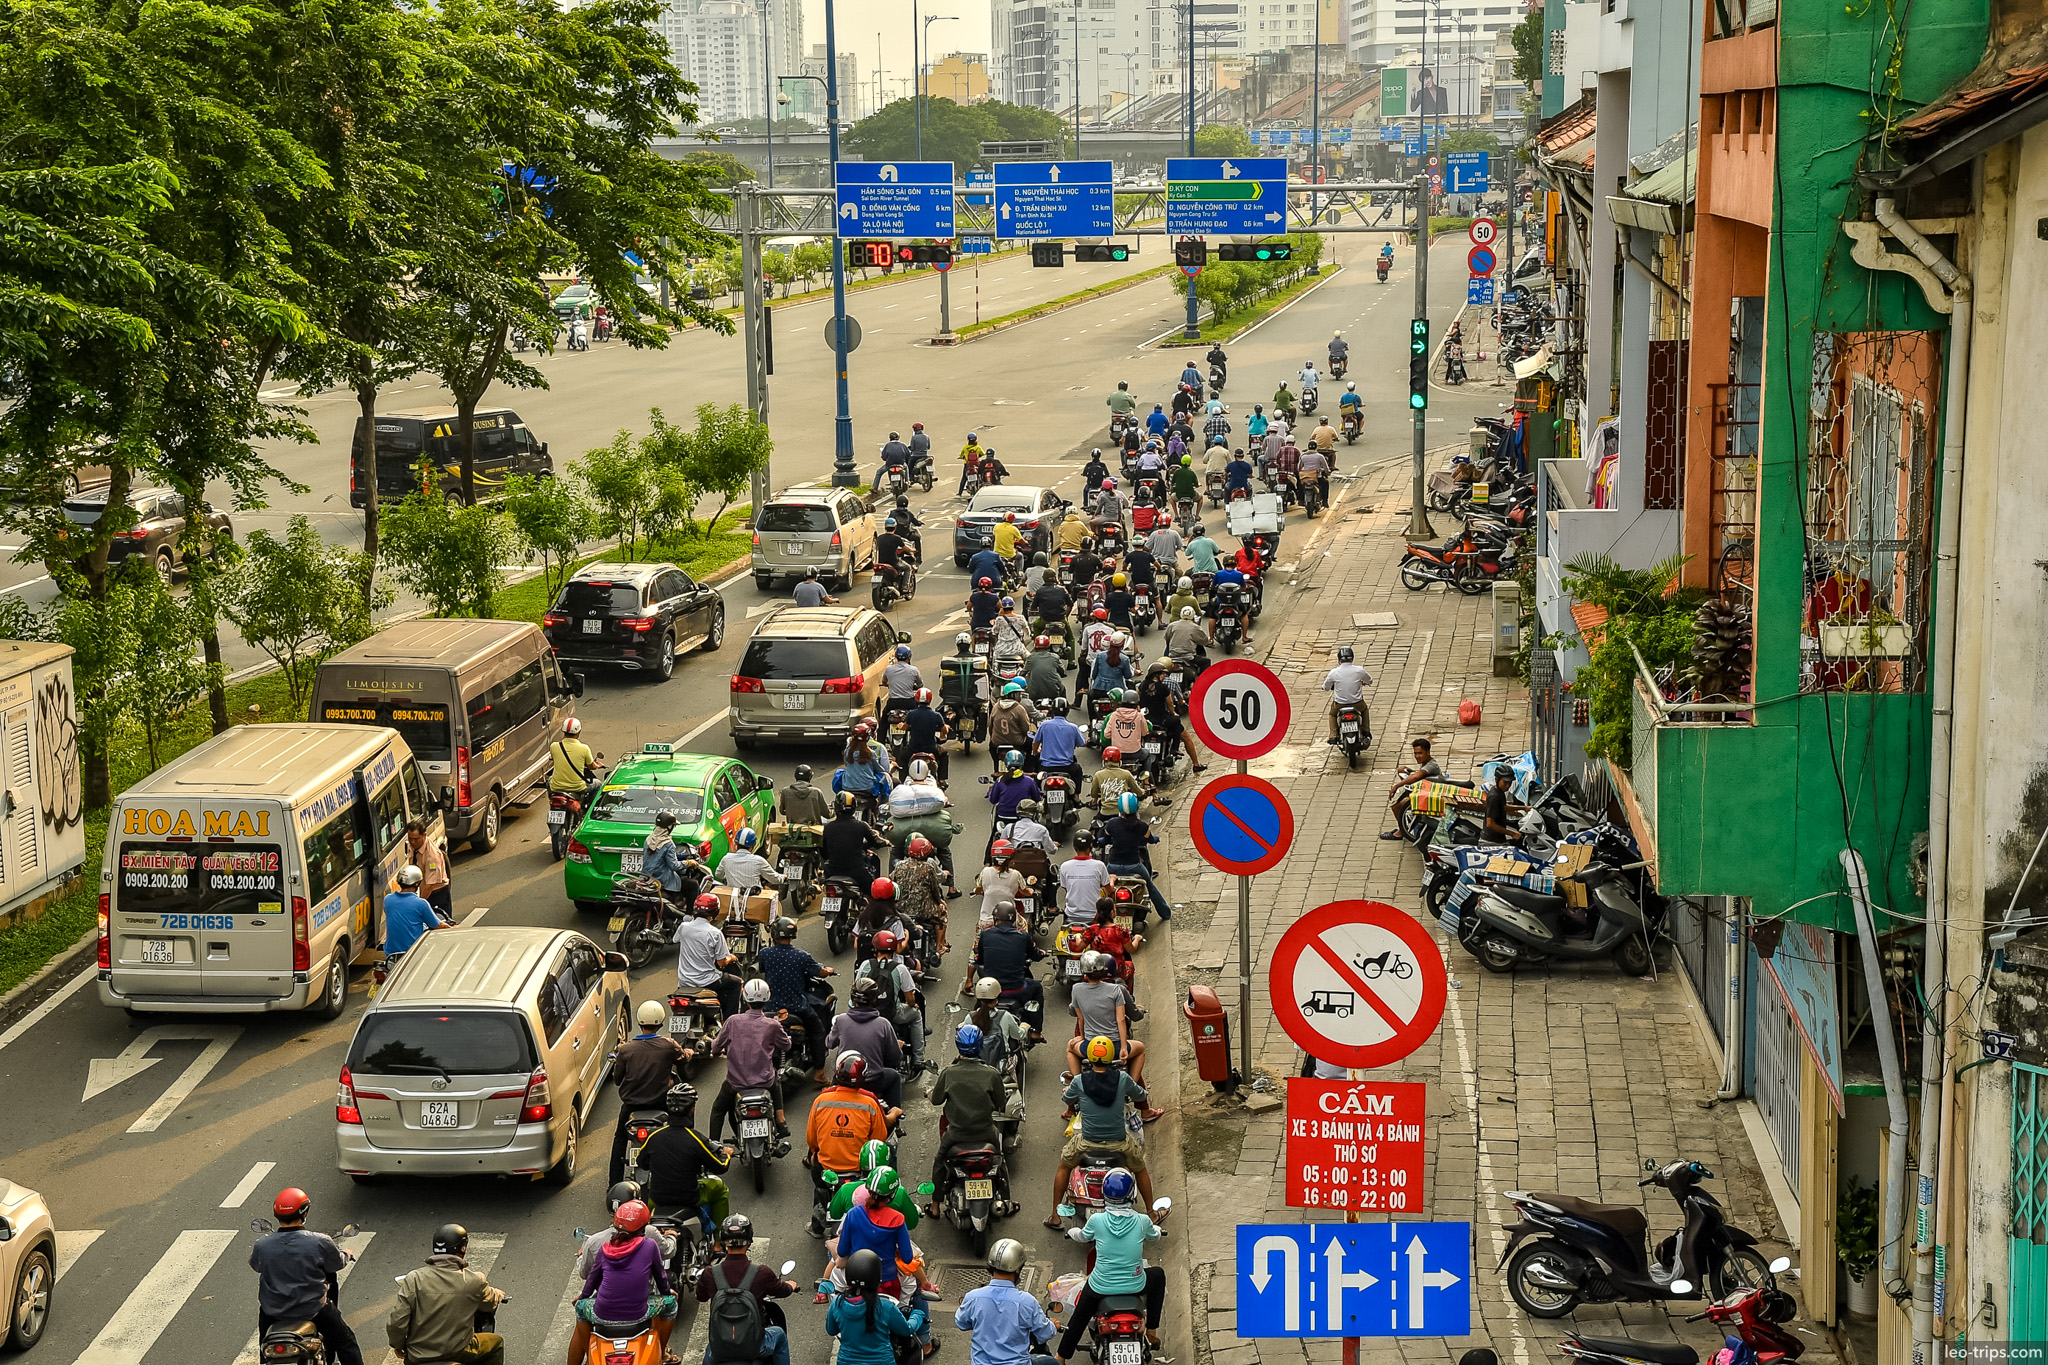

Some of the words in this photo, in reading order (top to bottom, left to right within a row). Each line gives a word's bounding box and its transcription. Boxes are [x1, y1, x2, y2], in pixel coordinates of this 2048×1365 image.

[1177, 202, 1204, 210] NGUYỄN
[1477, 227, 1489, 238] 50
[866, 243, 890, 266] 70
[1414, 322, 1425, 334] 64
[346, 680, 424, 689] LIMOUSINE
[325, 709, 376, 720] 0993.700.700
[392, 709, 444, 721] 0994.700.700
[1219, 689, 1260, 731] 50
[1000, 719, 1009, 735] 9
[123, 809, 197, 835] HOA
[203, 810, 270, 836] MAI
[173, 855, 197, 869] TÂY
[259, 852, 279, 871] 12
[628, 855, 641, 863] 51F
[125, 873, 188, 888] 0909.200.200
[211, 874, 275, 890] 0939.200.200
[149, 942, 166, 951] 72B
[143, 952, 172, 962] 016.36
[671, 1024, 687, 1032] 9925
[1319, 1084, 1394, 1115] CẤM
[429, 1102, 449, 1114] 62A
[421, 1114, 457, 1127] 048.46
[743, 1129, 768, 1138] 064.64
[1292, 1119, 1306, 1137] XE
[1311, 1120, 1318, 1137] 3
[1322, 1117, 1353, 1140] BÁNH
[1357, 1118, 1372, 1140] VÀ
[1376, 1124, 1384, 1141] 4
[1388, 1120, 1419, 1142] BÁNH
[1334, 1141, 1357, 1163] THÔ
[1361, 1144, 1377, 1163] SƠ
[967, 1190, 992, 1199] 398.84
[1114, 1344, 1136, 1353] 59-C1
[1112, 1353, 1139, 1364] 690.46
